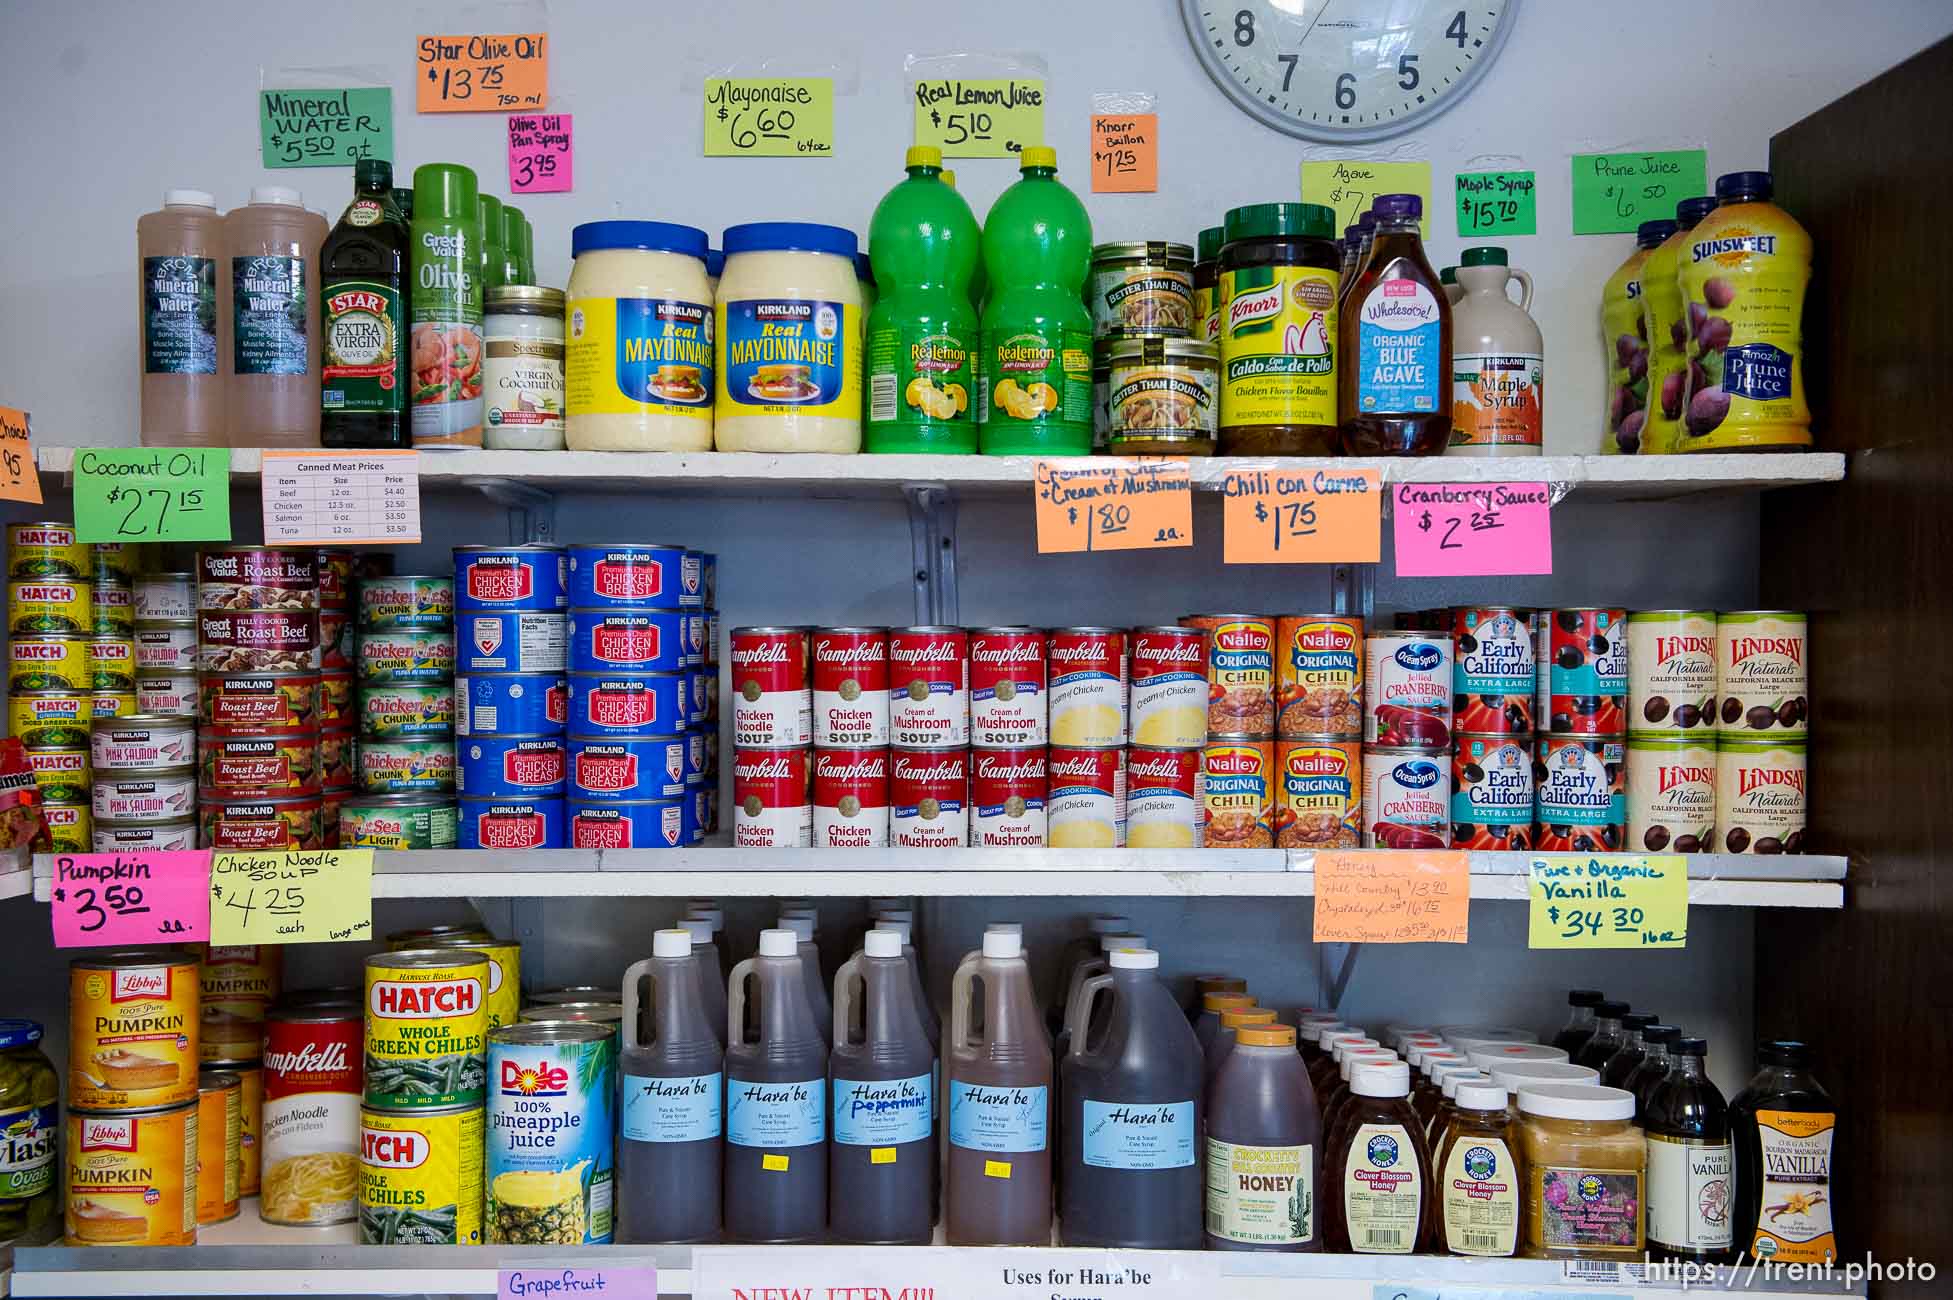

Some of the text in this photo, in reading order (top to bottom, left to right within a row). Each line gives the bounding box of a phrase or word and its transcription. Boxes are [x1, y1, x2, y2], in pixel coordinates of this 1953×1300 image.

[1234, 10, 1254, 47] 8
[1446, 11, 1468, 48] 4
[419, 36, 544, 62] Star Olive Oil
[1278, 54, 1299, 92] 7
[1399, 55, 1419, 90] 5
[708, 83, 812, 113] Mayonaise
[916, 82, 1042, 109] Real Lemon Juice
[1335, 73, 1356, 109] 6
[266, 92, 350, 118] Mineral
[497, 94, 541, 106] 750 ml
[276, 116, 380, 133] WATER
[509, 117, 560, 132] Olive Oil
[1096, 120, 1135, 133] Knorr
[512, 133, 569, 151] Pan Spray
[1333, 165, 1374, 183] Agave
[1594, 160, 1680, 176] Prune Juice
[1457, 177, 1533, 197] Maple Syrup
[1693, 236, 1776, 265] SUNSWEET
[420, 264, 471, 289] Olive
[244, 279, 290, 294] Mineral
[1108, 280, 1168, 304] BETTER THAN
[250, 297, 285, 312] Water
[334, 295, 379, 313] STAR
[757, 304, 811, 316] KIRKLAND
[1231, 296, 1280, 322] Knorr
[336, 322, 380, 336] EXTRA
[761, 324, 803, 338] Real
[336, 336, 381, 348] VIRGIN
[1373, 335, 1425, 347] ORGANIC
[731, 337, 835, 368] MAYONNAISE
[911, 344, 965, 362] ReaLemon
[1380, 348, 1417, 365] BLUE
[1232, 361, 1263, 378] Caldo
[1288, 360, 1304, 373] de
[1306, 358, 1331, 372] Pollo
[1373, 366, 1425, 383] AGAVE
[1236, 387, 1267, 397] Chicken
[1297, 385, 1329, 396] Bouillon
[1481, 377, 1527, 391] Maple
[1483, 393, 1528, 411] Syrup
[81, 453, 205, 477] Coconut Oil
[298, 462, 384, 473] Canned Meat Prices
[279, 477, 404, 486] Item Size Price
[1224, 472, 1368, 497] Chili con Carne
[279, 488, 406, 498] Beef $4.40
[1399, 484, 1548, 513] Cranberry Sauce
[274, 501, 407, 511] Chicken $2.50
[275, 513, 407, 523] Salmon $3.50
[280, 528, 299, 536] Tuna
[478, 557, 519, 566] KIRKLAND
[244, 564, 312, 577] Roast Beef
[475, 576, 523, 587] CHICKEN
[477, 586, 522, 597] BREAST
[1221, 633, 1269, 648] Nalley
[817, 640, 886, 666] Campbell's
[1398, 650, 1439, 666] Ocean Spray
[1481, 640, 1525, 659] Early
[1216, 654, 1270, 667] ORIGINAL
[1463, 656, 1535, 675] California
[1741, 659, 1795, 676] Naturals
[1224, 671, 1266, 683] CHILI
[1386, 682, 1448, 700] CRANBERRY
[829, 708, 873, 720] Chicken
[904, 707, 935, 717] Cream of
[894, 715, 952, 730] Mushroom
[129, 748, 158, 761] SALMON
[374, 770, 404, 780] CHUNK
[58, 858, 151, 882] Pumpkin
[216, 852, 340, 874] Chicken Noodle
[1533, 860, 1572, 878] Pure
[1589, 858, 1664, 879] Organic
[1540, 881, 1627, 901] Vanilla
[275, 920, 305, 934] each
[124, 974, 162, 991] Libby's
[380, 985, 474, 1014] HATCH
[95, 1015, 184, 1035] PUMPKIN
[400, 1025, 450, 1039] WHOLE
[371, 1036, 480, 1057] GREEN CHILES
[502, 1060, 569, 1096] Dole
[643, 1080, 708, 1099] Hara'be
[513, 1101, 552, 1113] 100%
[493, 1112, 581, 1132] pineapple
[510, 1131, 556, 1150] juice
[1368, 1135, 1398, 1148] CROCKETT
[1766, 1154, 1828, 1175] VANILLA
[1239, 1175, 1295, 1192] HONEY
[1355, 1171, 1412, 1182] Clover Blossom
[509, 1273, 606, 1296] Grapefruit
[1002, 1268, 1151, 1287] Uses for Hara'be
